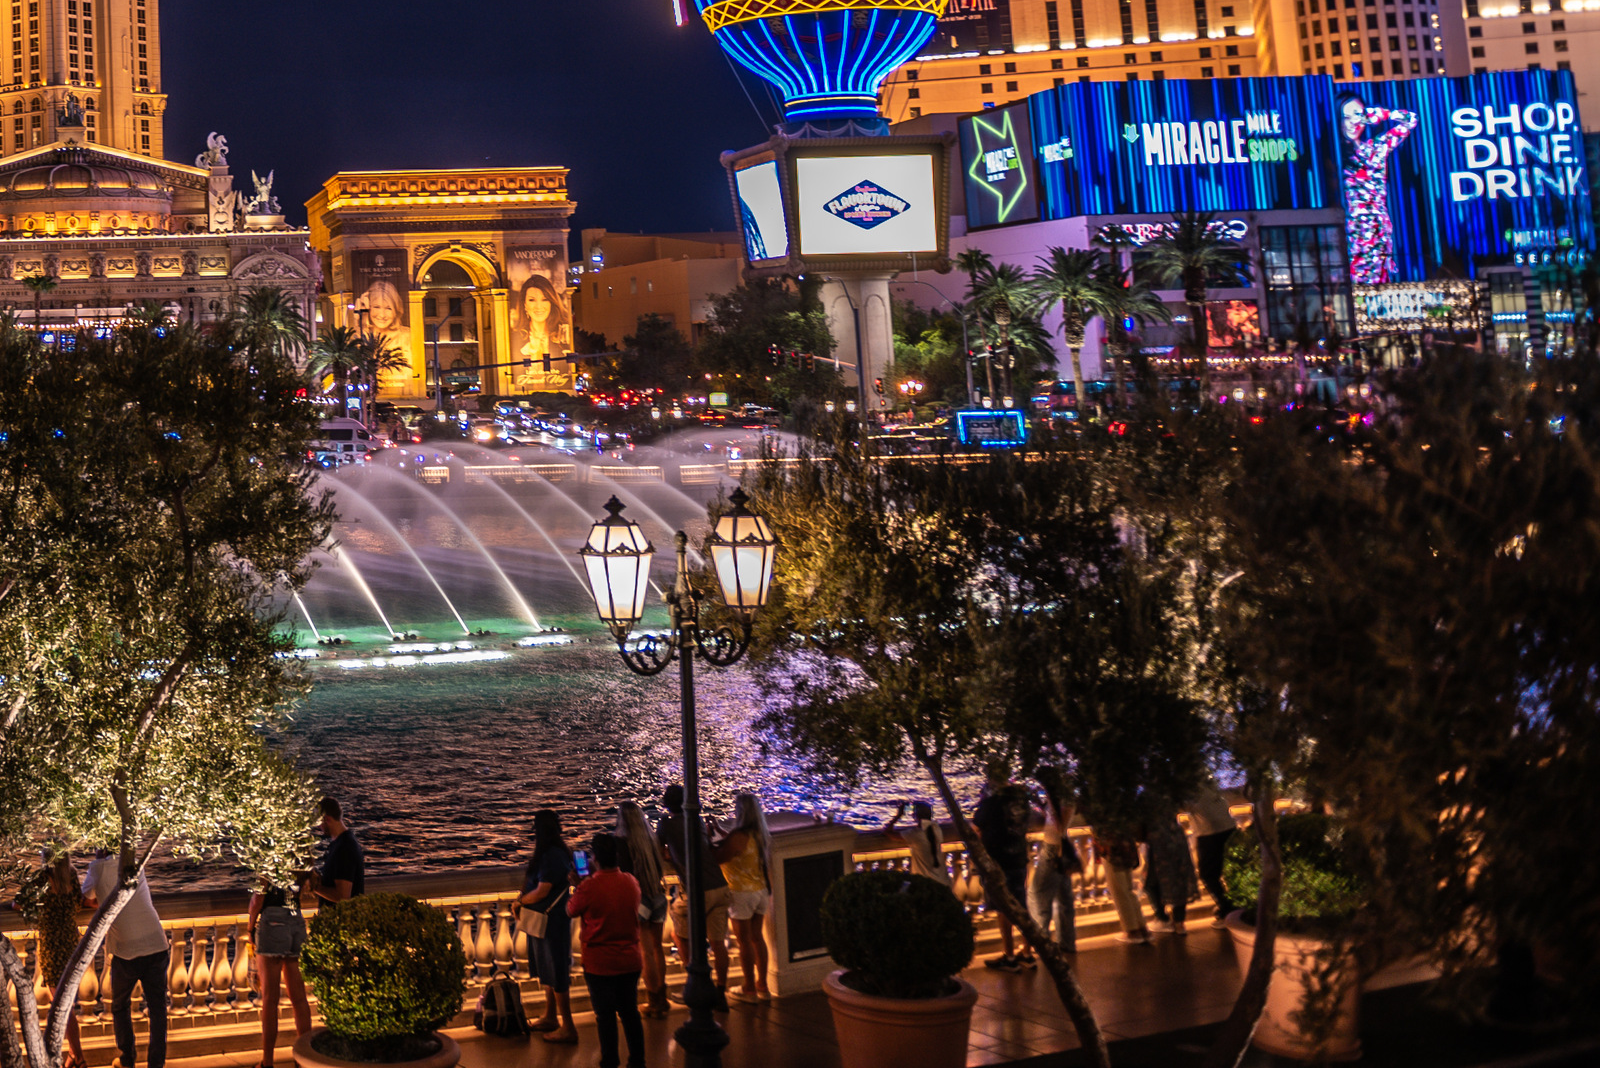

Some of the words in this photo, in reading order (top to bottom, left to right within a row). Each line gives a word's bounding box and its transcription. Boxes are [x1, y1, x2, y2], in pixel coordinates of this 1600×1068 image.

[1245, 110, 1282, 134] MILE
[1141, 120, 1249, 166] MIRACLE
[1248, 138, 1298, 162] SHOPS
[1450, 167, 1590, 201] DRINK
[828, 192, 907, 214] FLAVORTOWN
[513, 249, 557, 260] VANDERPUMP
